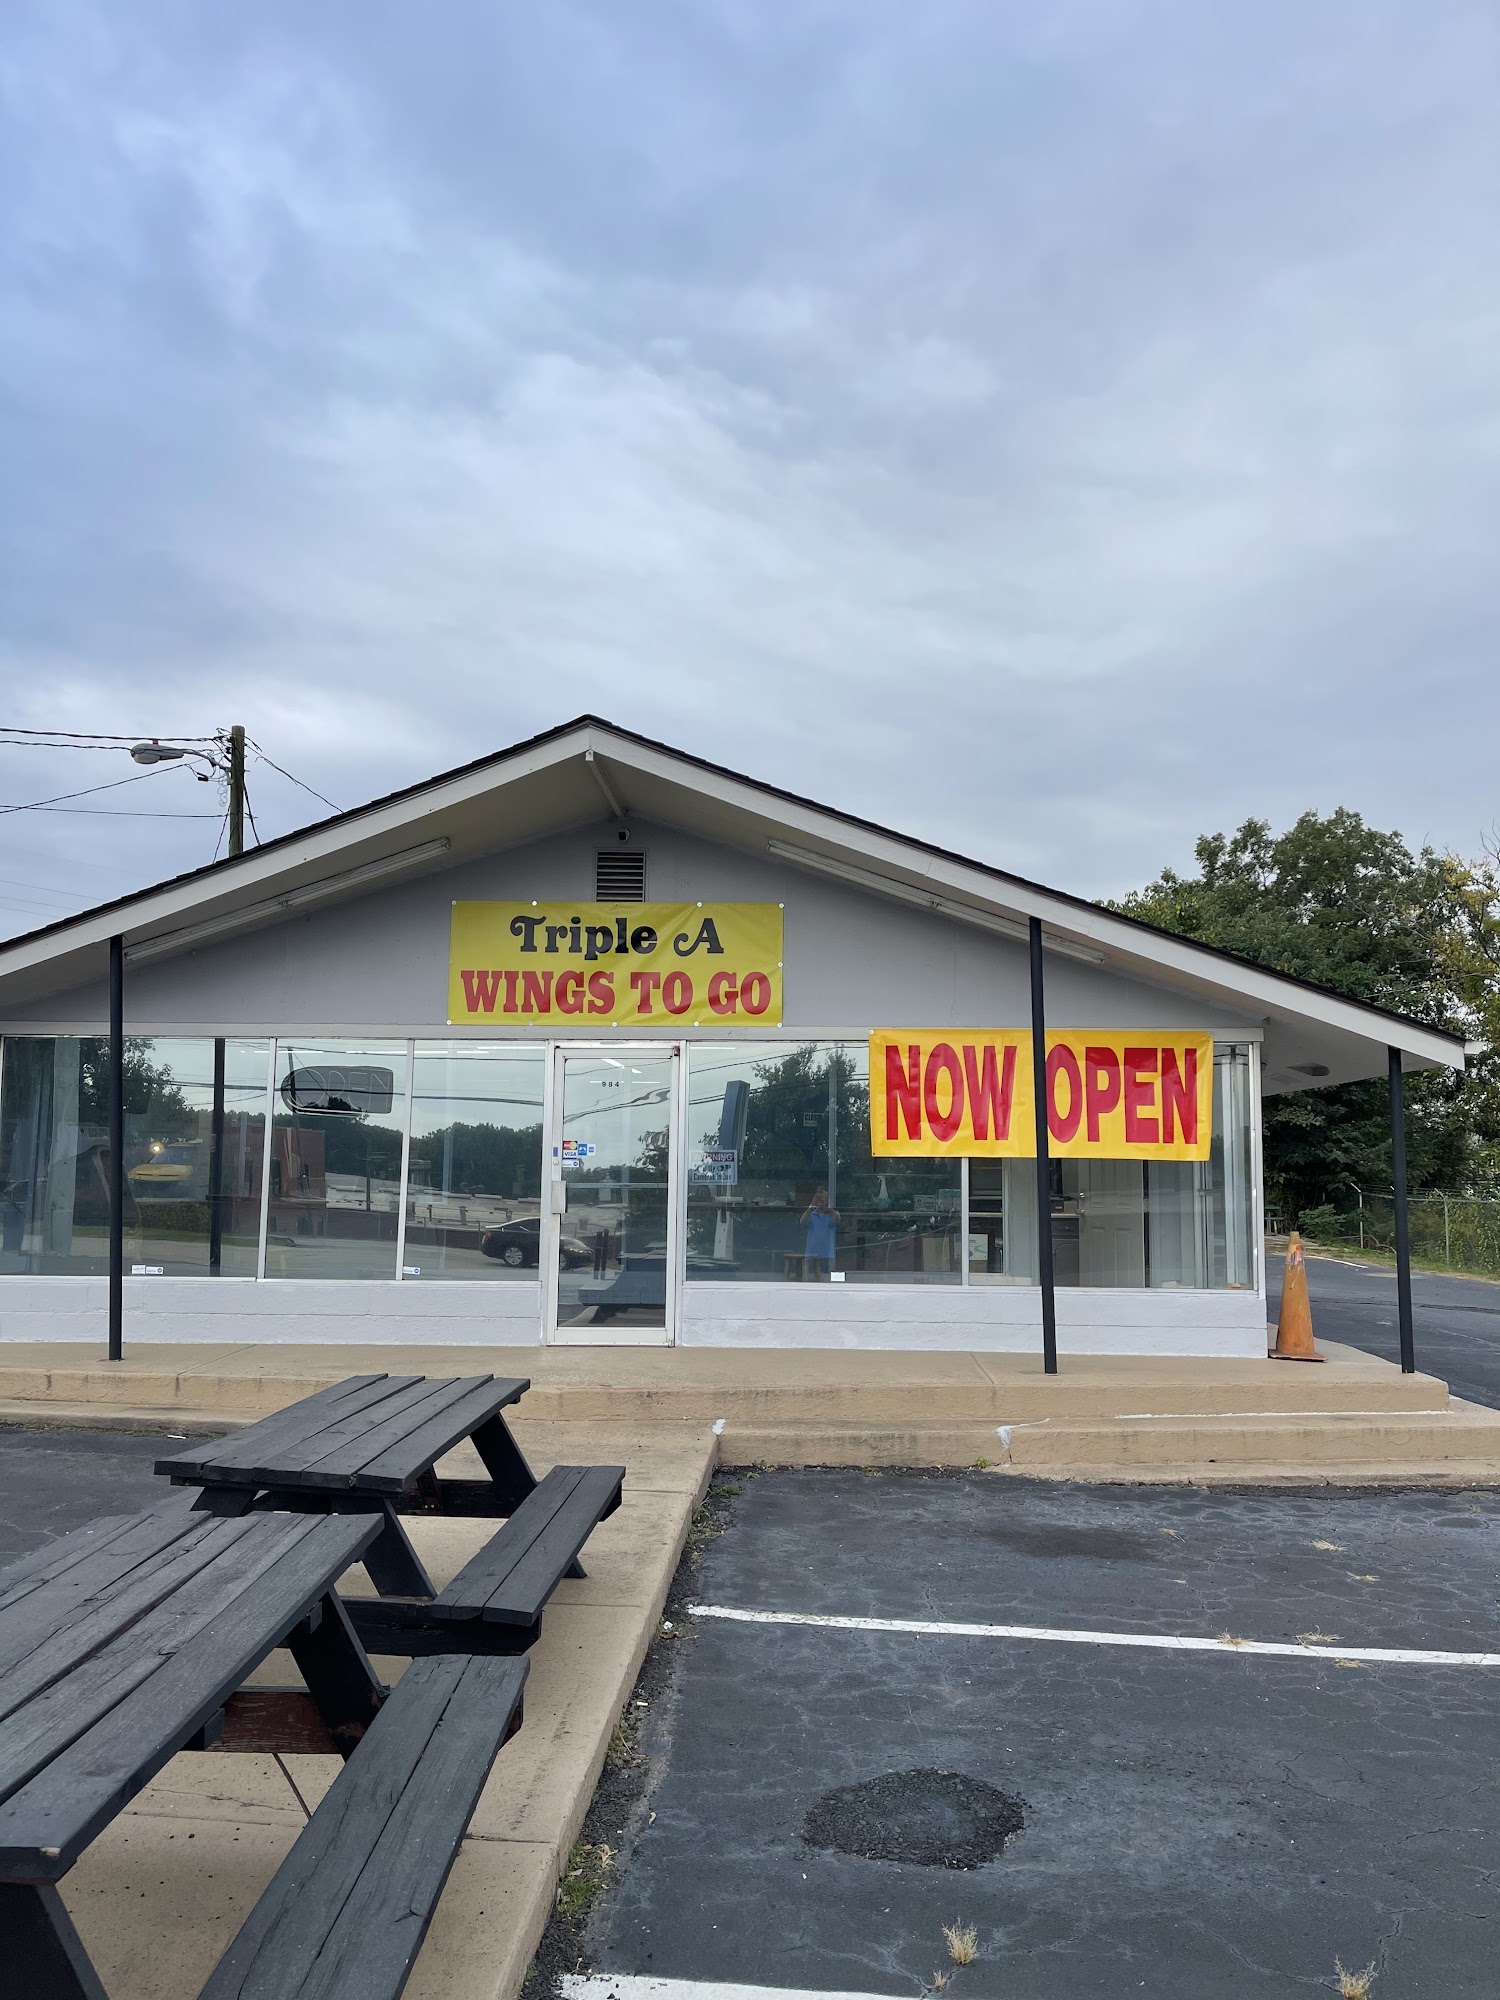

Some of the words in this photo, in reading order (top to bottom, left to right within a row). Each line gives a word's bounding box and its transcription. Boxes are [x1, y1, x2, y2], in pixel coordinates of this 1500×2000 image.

[510, 916, 657, 960] Triple
[673, 918, 724, 957] A
[461, 970, 615, 1014] WINGS
[630, 971, 693, 1014] TO
[707, 971, 772, 1015] GO
[289, 1069, 391, 1111] OPEN
[885, 1043, 1017, 1142] NOW
[1046, 1044, 1197, 1144] OPEN
